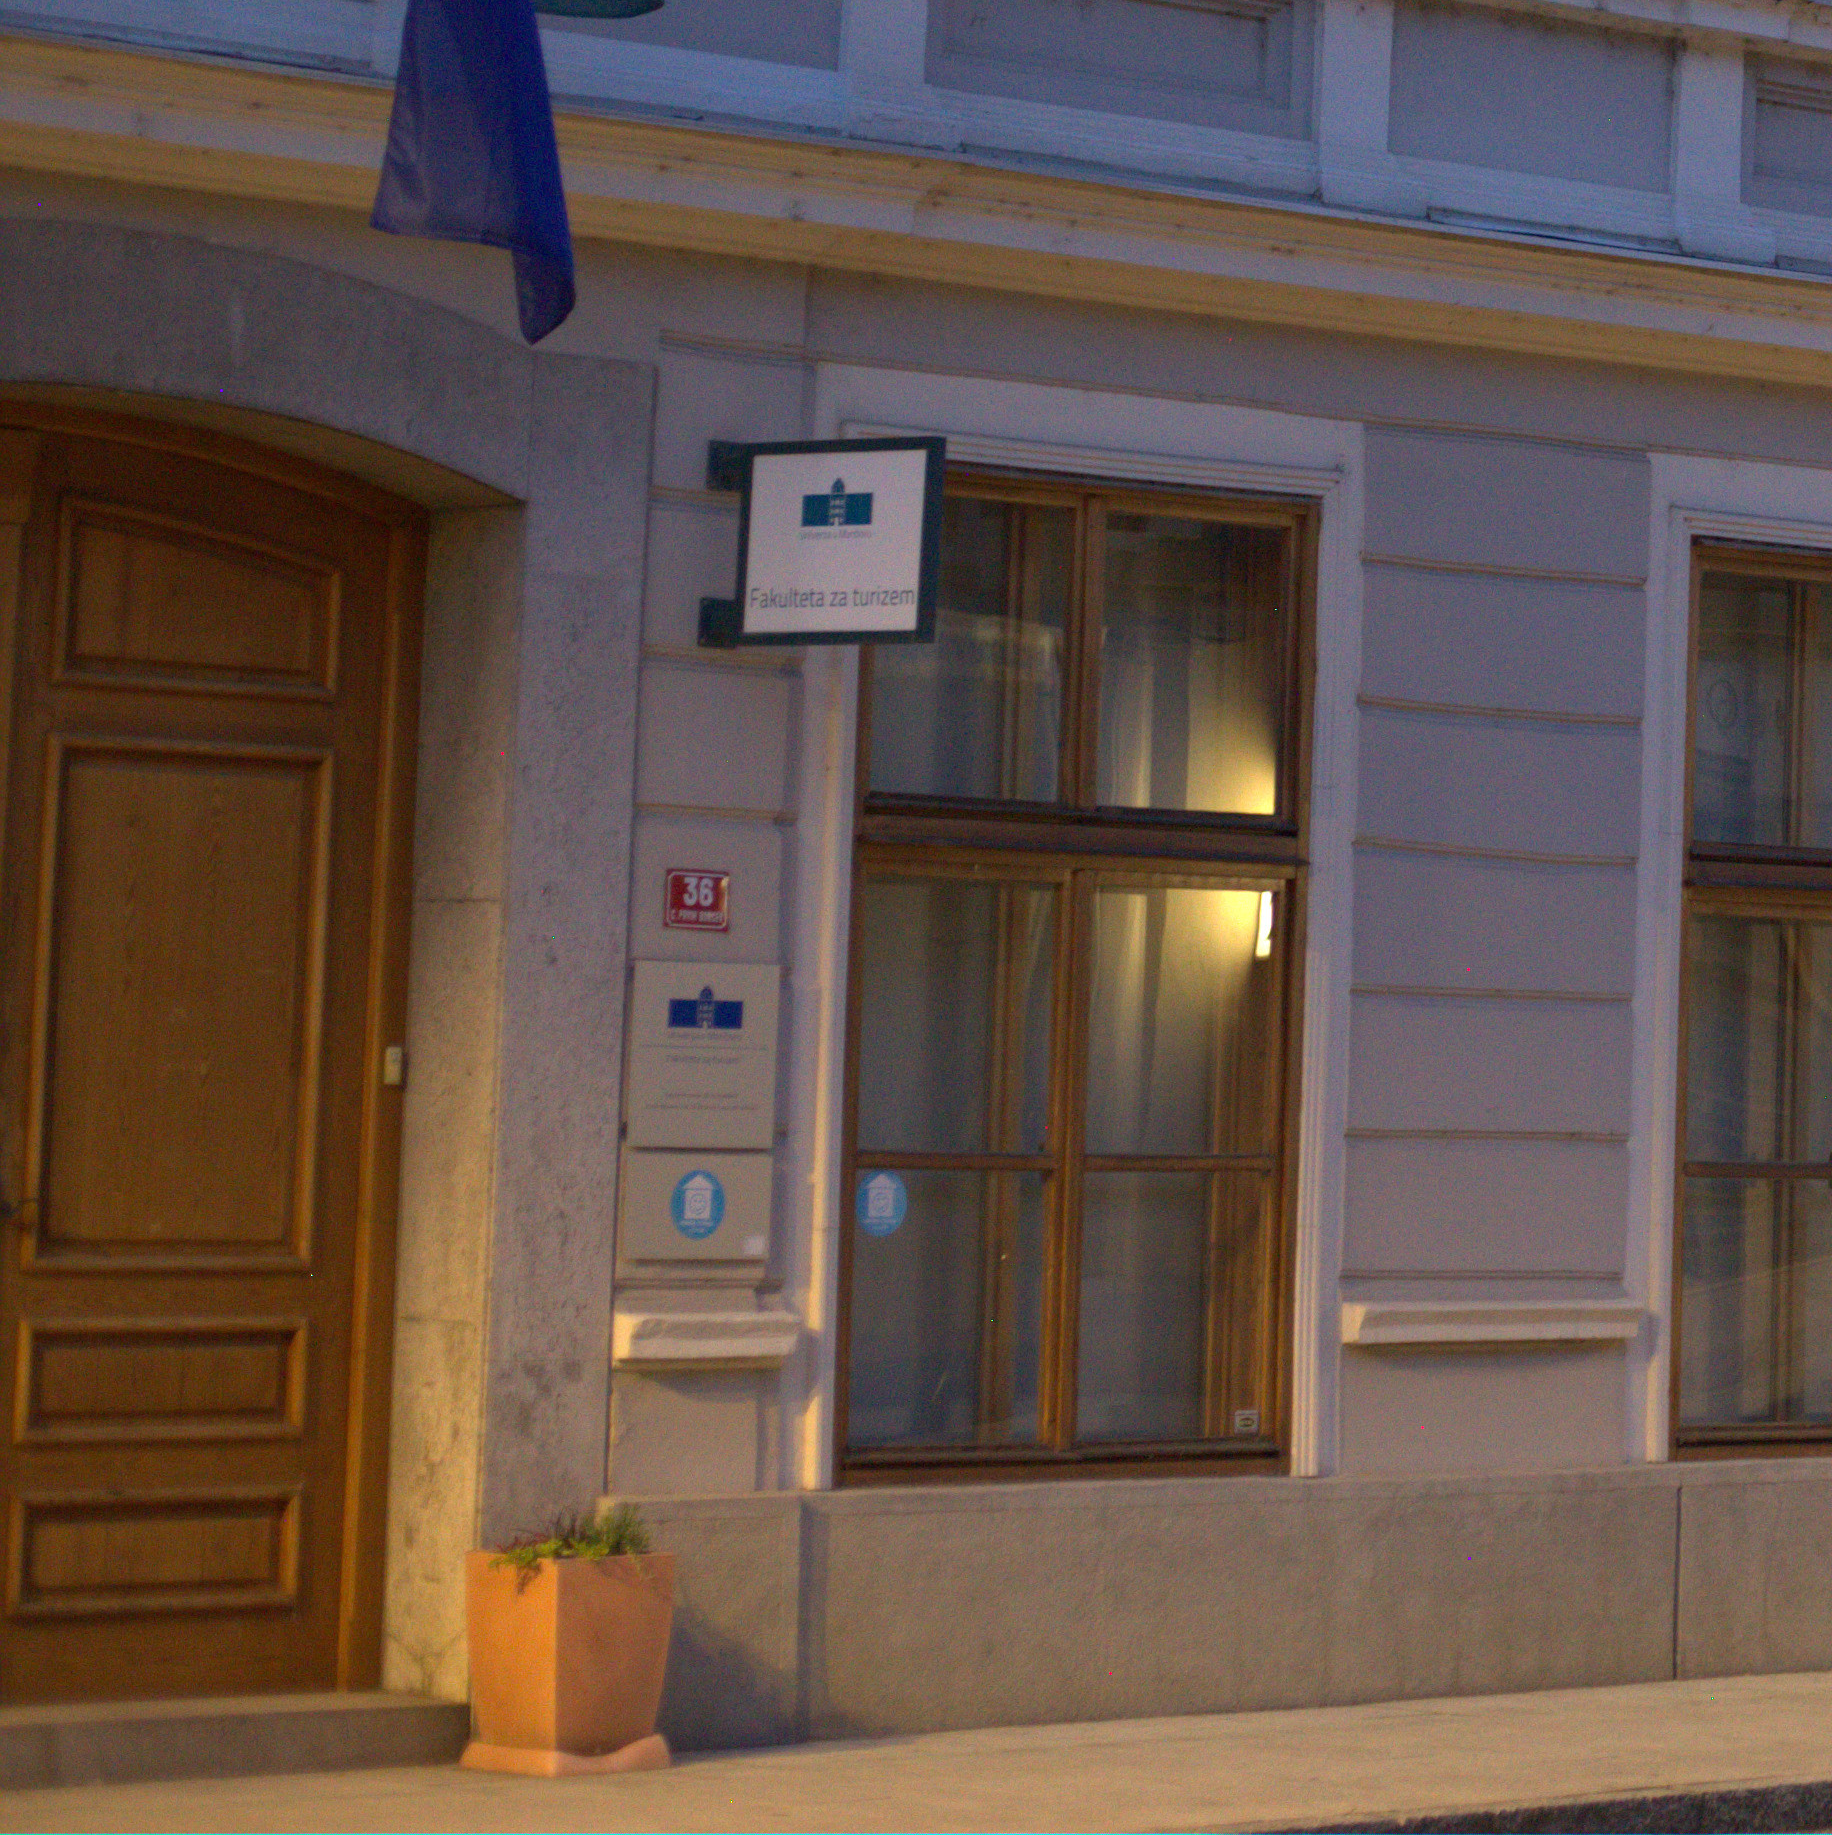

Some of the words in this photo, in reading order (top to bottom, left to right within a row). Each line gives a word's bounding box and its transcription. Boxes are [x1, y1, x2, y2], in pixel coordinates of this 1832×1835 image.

[750, 588, 825, 609] Fakulteta
[829, 590, 848, 607] za
[852, 585, 916, 607] turizem
[683, 876, 714, 907] 36
